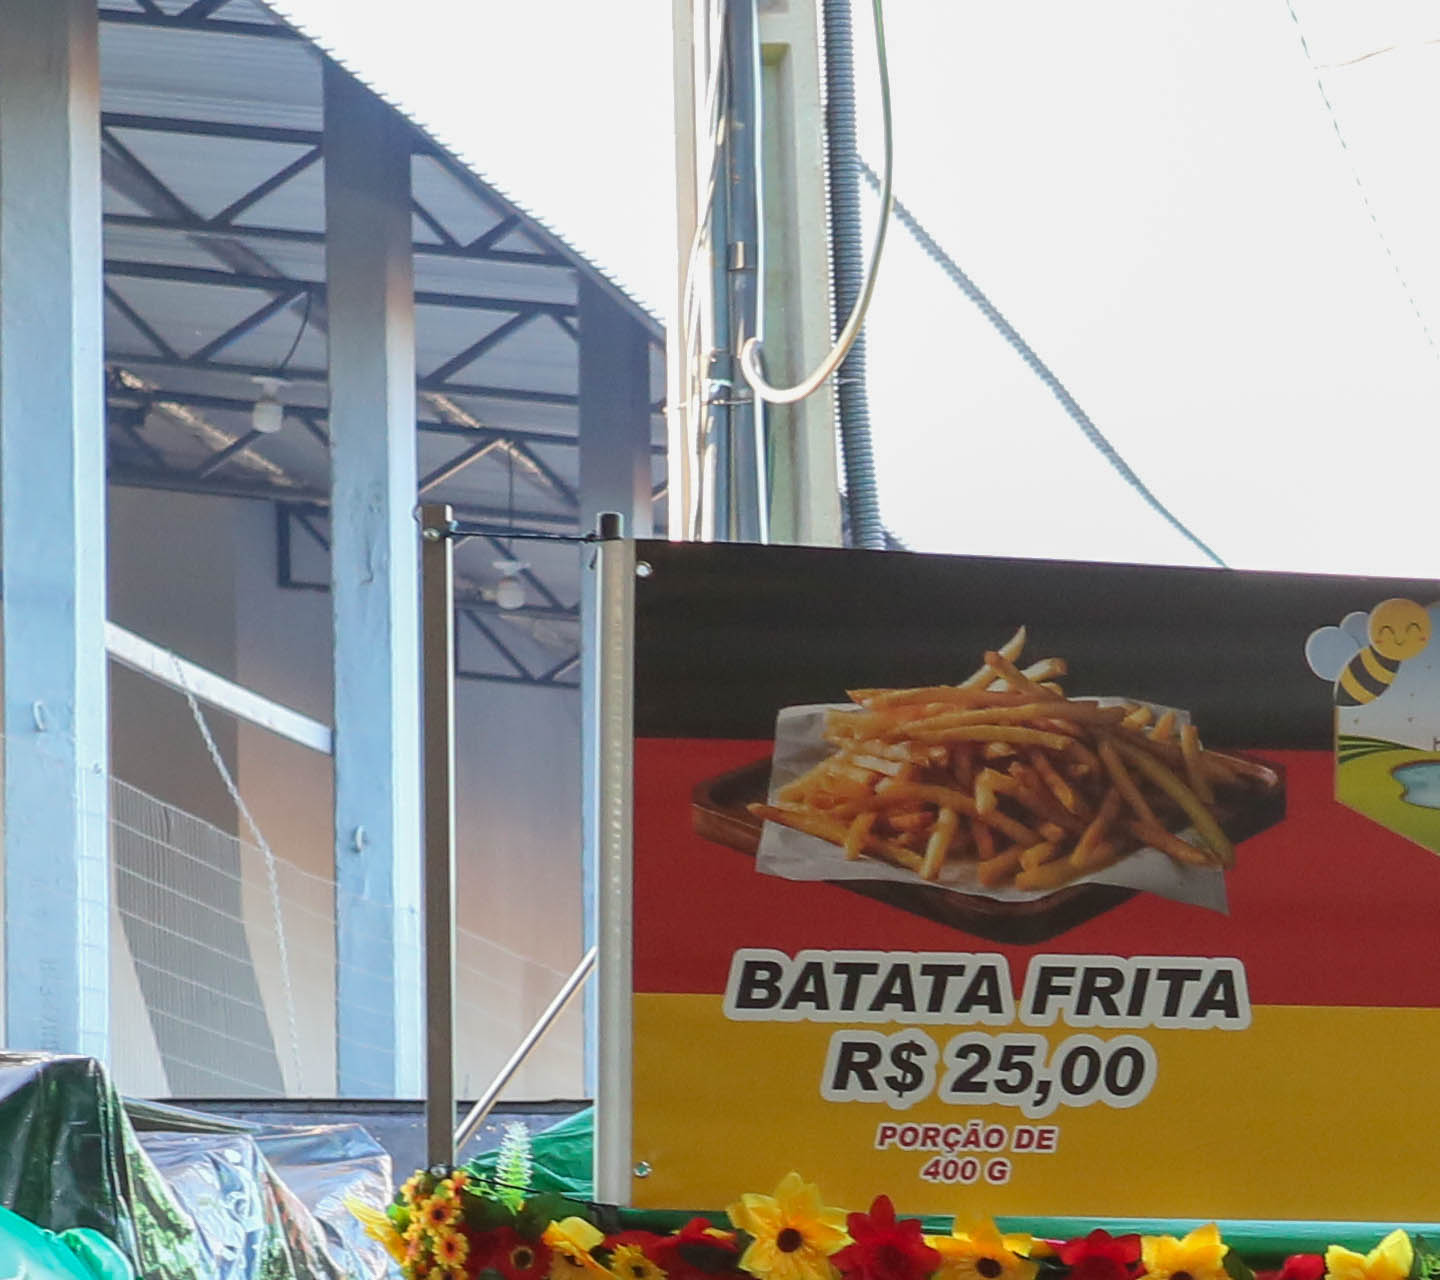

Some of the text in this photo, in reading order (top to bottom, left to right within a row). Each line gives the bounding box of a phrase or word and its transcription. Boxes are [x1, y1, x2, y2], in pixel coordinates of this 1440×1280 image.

[732, 958, 1241, 1019] BATATA FRITA
[831, 1037, 1146, 1107] R$ 25,00
[877, 1121, 1057, 1154] PORÇÃO DE
[923, 1158, 1009, 1183] 400 G
